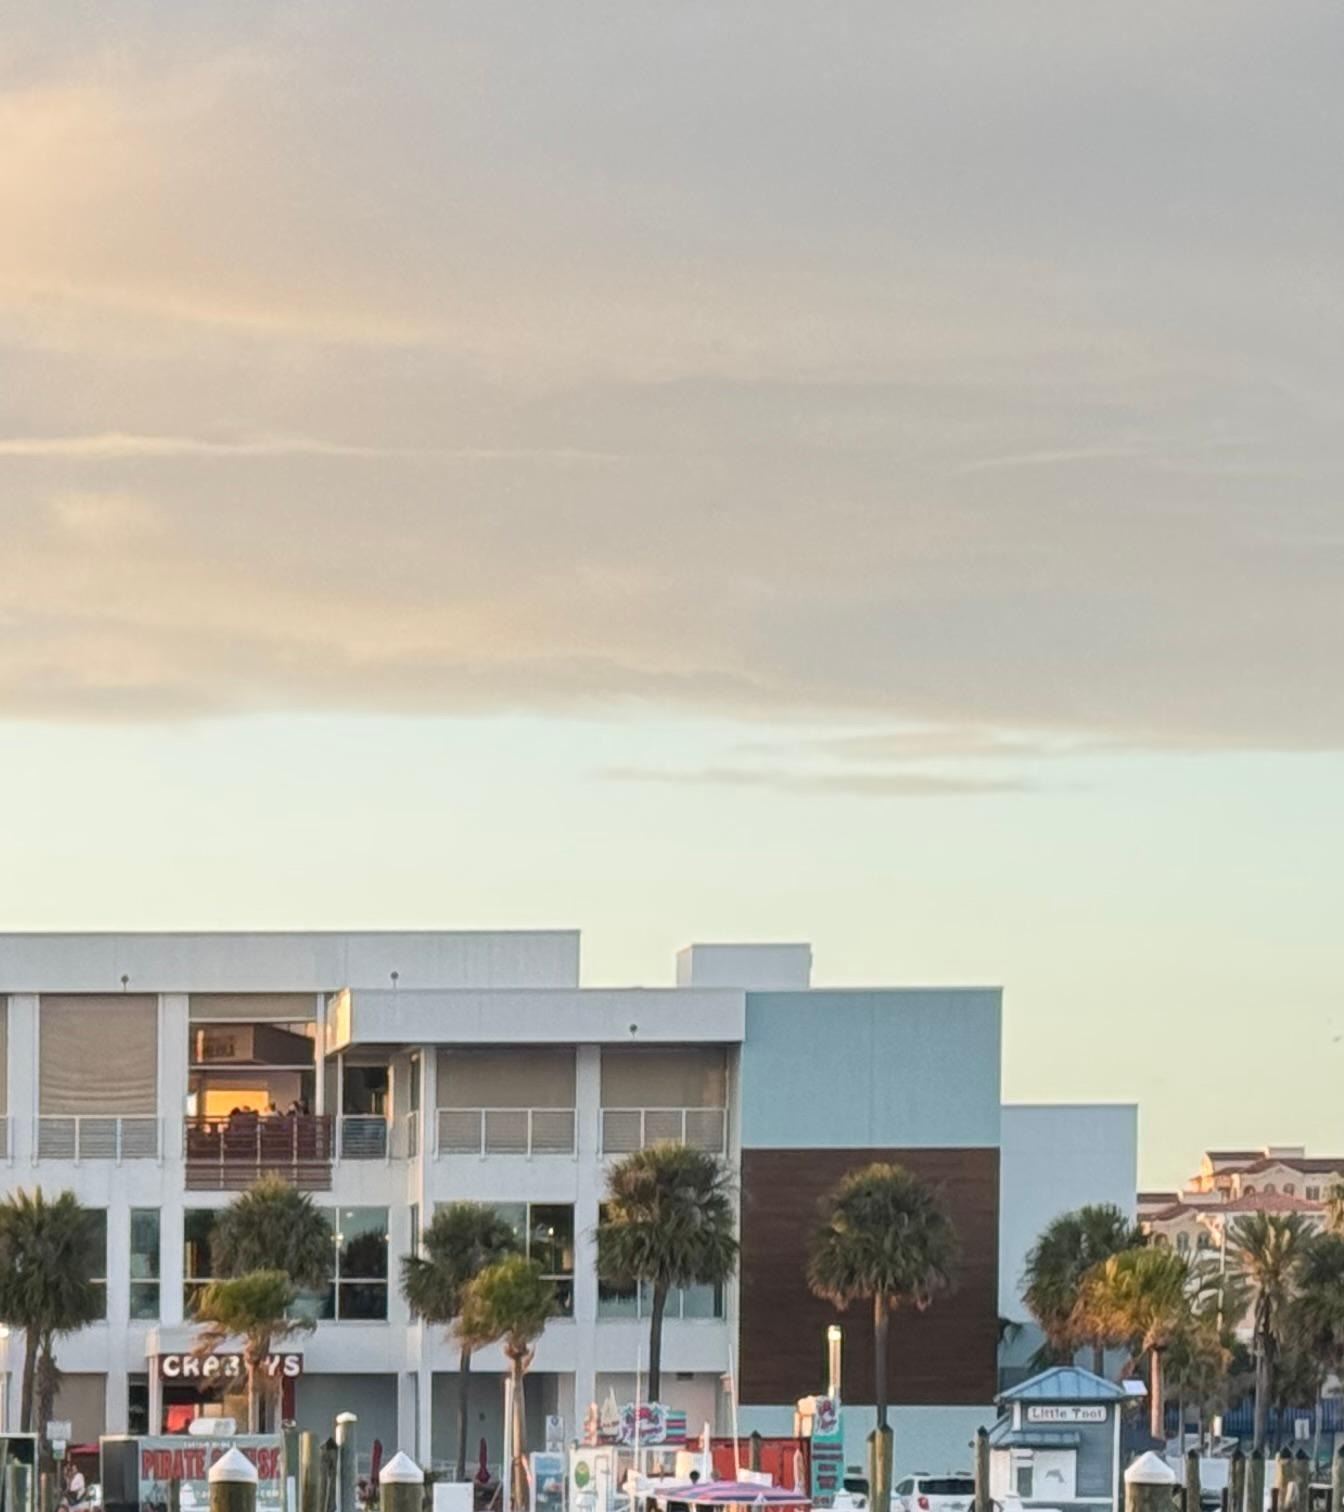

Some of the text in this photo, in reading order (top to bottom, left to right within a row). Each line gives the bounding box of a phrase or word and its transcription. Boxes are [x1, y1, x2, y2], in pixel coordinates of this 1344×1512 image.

[163, 1355, 300, 1377] CRABYS
[1032, 1408, 1103, 1419] Little Toot
[142, 1447, 281, 1480] PIRATE CISE
